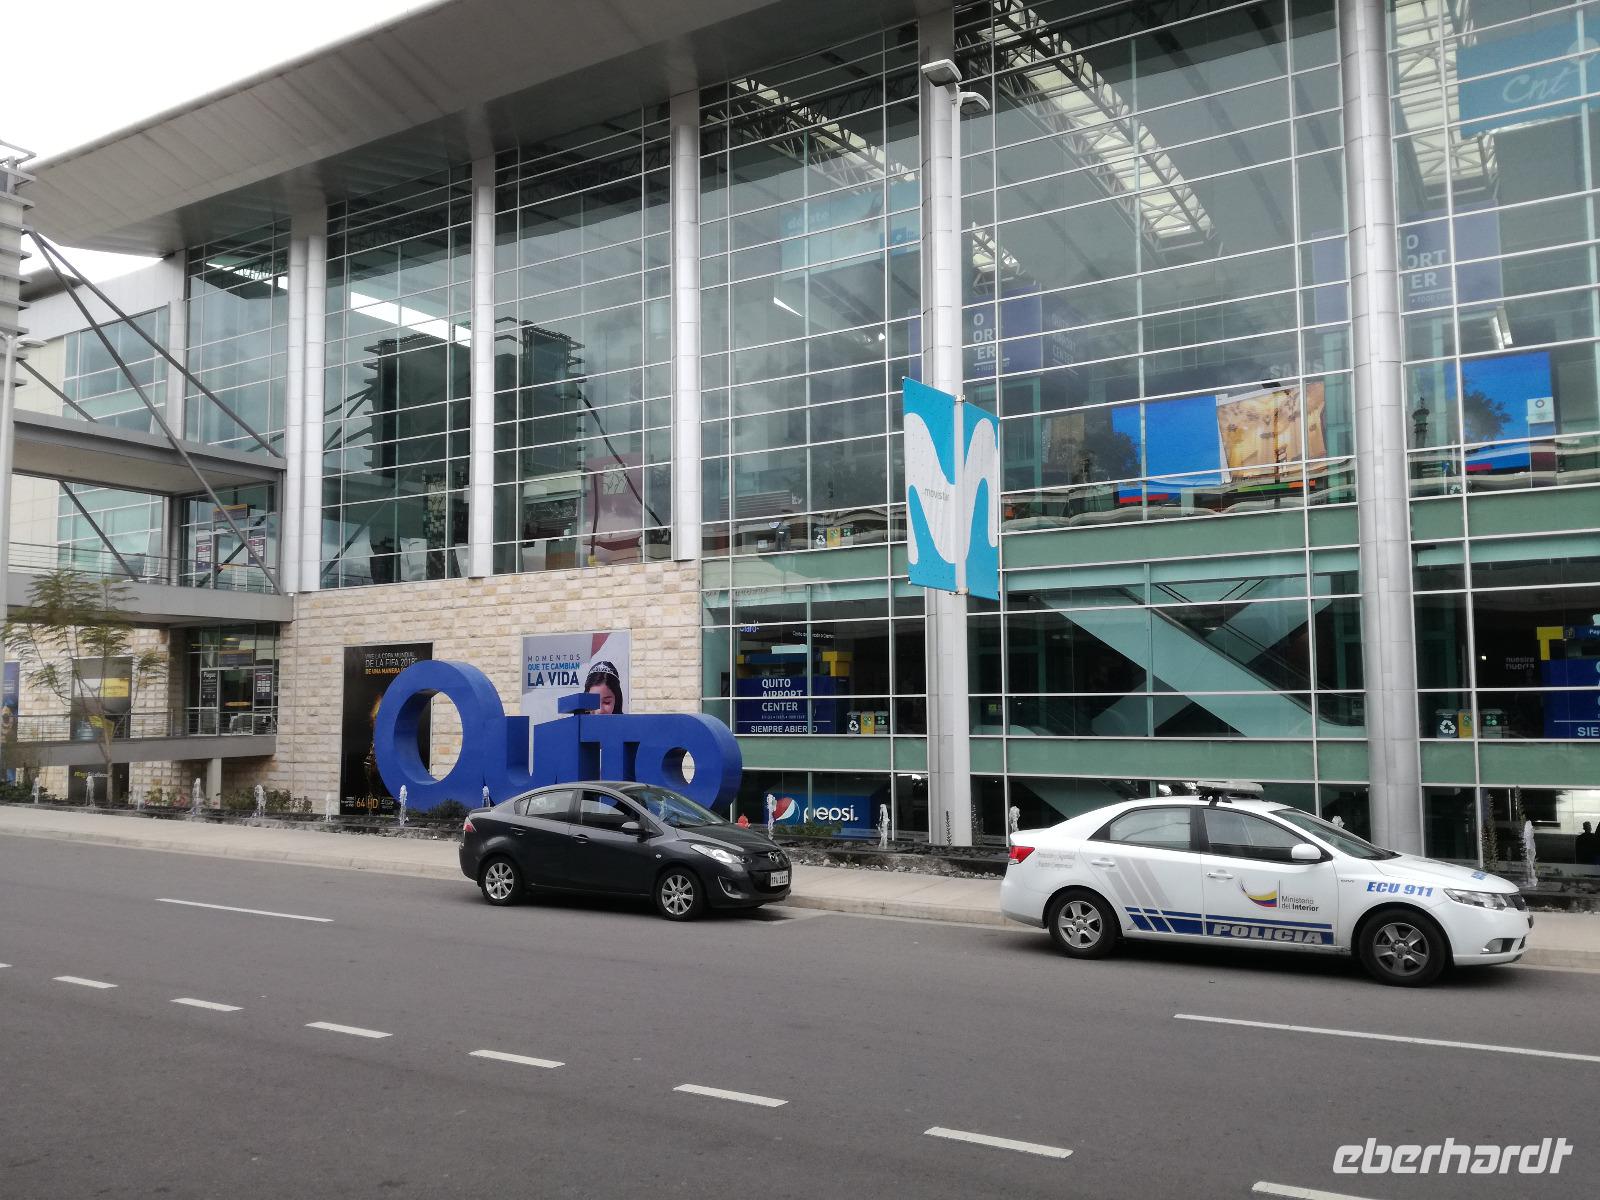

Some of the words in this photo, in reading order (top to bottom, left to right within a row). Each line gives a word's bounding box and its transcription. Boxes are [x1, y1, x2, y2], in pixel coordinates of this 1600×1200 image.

[528, 654, 580, 662] MOMENTOS
[365, 660, 374, 668] DE
[376, 659, 383, 667] LA
[385, 659, 399, 667] FIFA
[528, 663, 540, 671] QUE
[550, 662, 580, 670] CAMBIAN
[527, 672, 545, 687] LA
[548, 671, 580, 686] VIDA
[762, 679, 791, 689] QUITO
[762, 702, 798, 711] CENTER
[751, 725, 783, 733] SIEMPRE
[785, 725, 818, 733] ABIERO
[1577, 726, 1600, 738] SIE
[356, 797, 365, 808] 64
[367, 798, 378, 809] HD
[1366, 881, 1400, 893] ECU
[1403, 884, 1433, 897] 911
[1281, 895, 1314, 904] Ministerio
[1292, 903, 1319, 912] Interior
[1213, 923, 1323, 945] POLICIA
